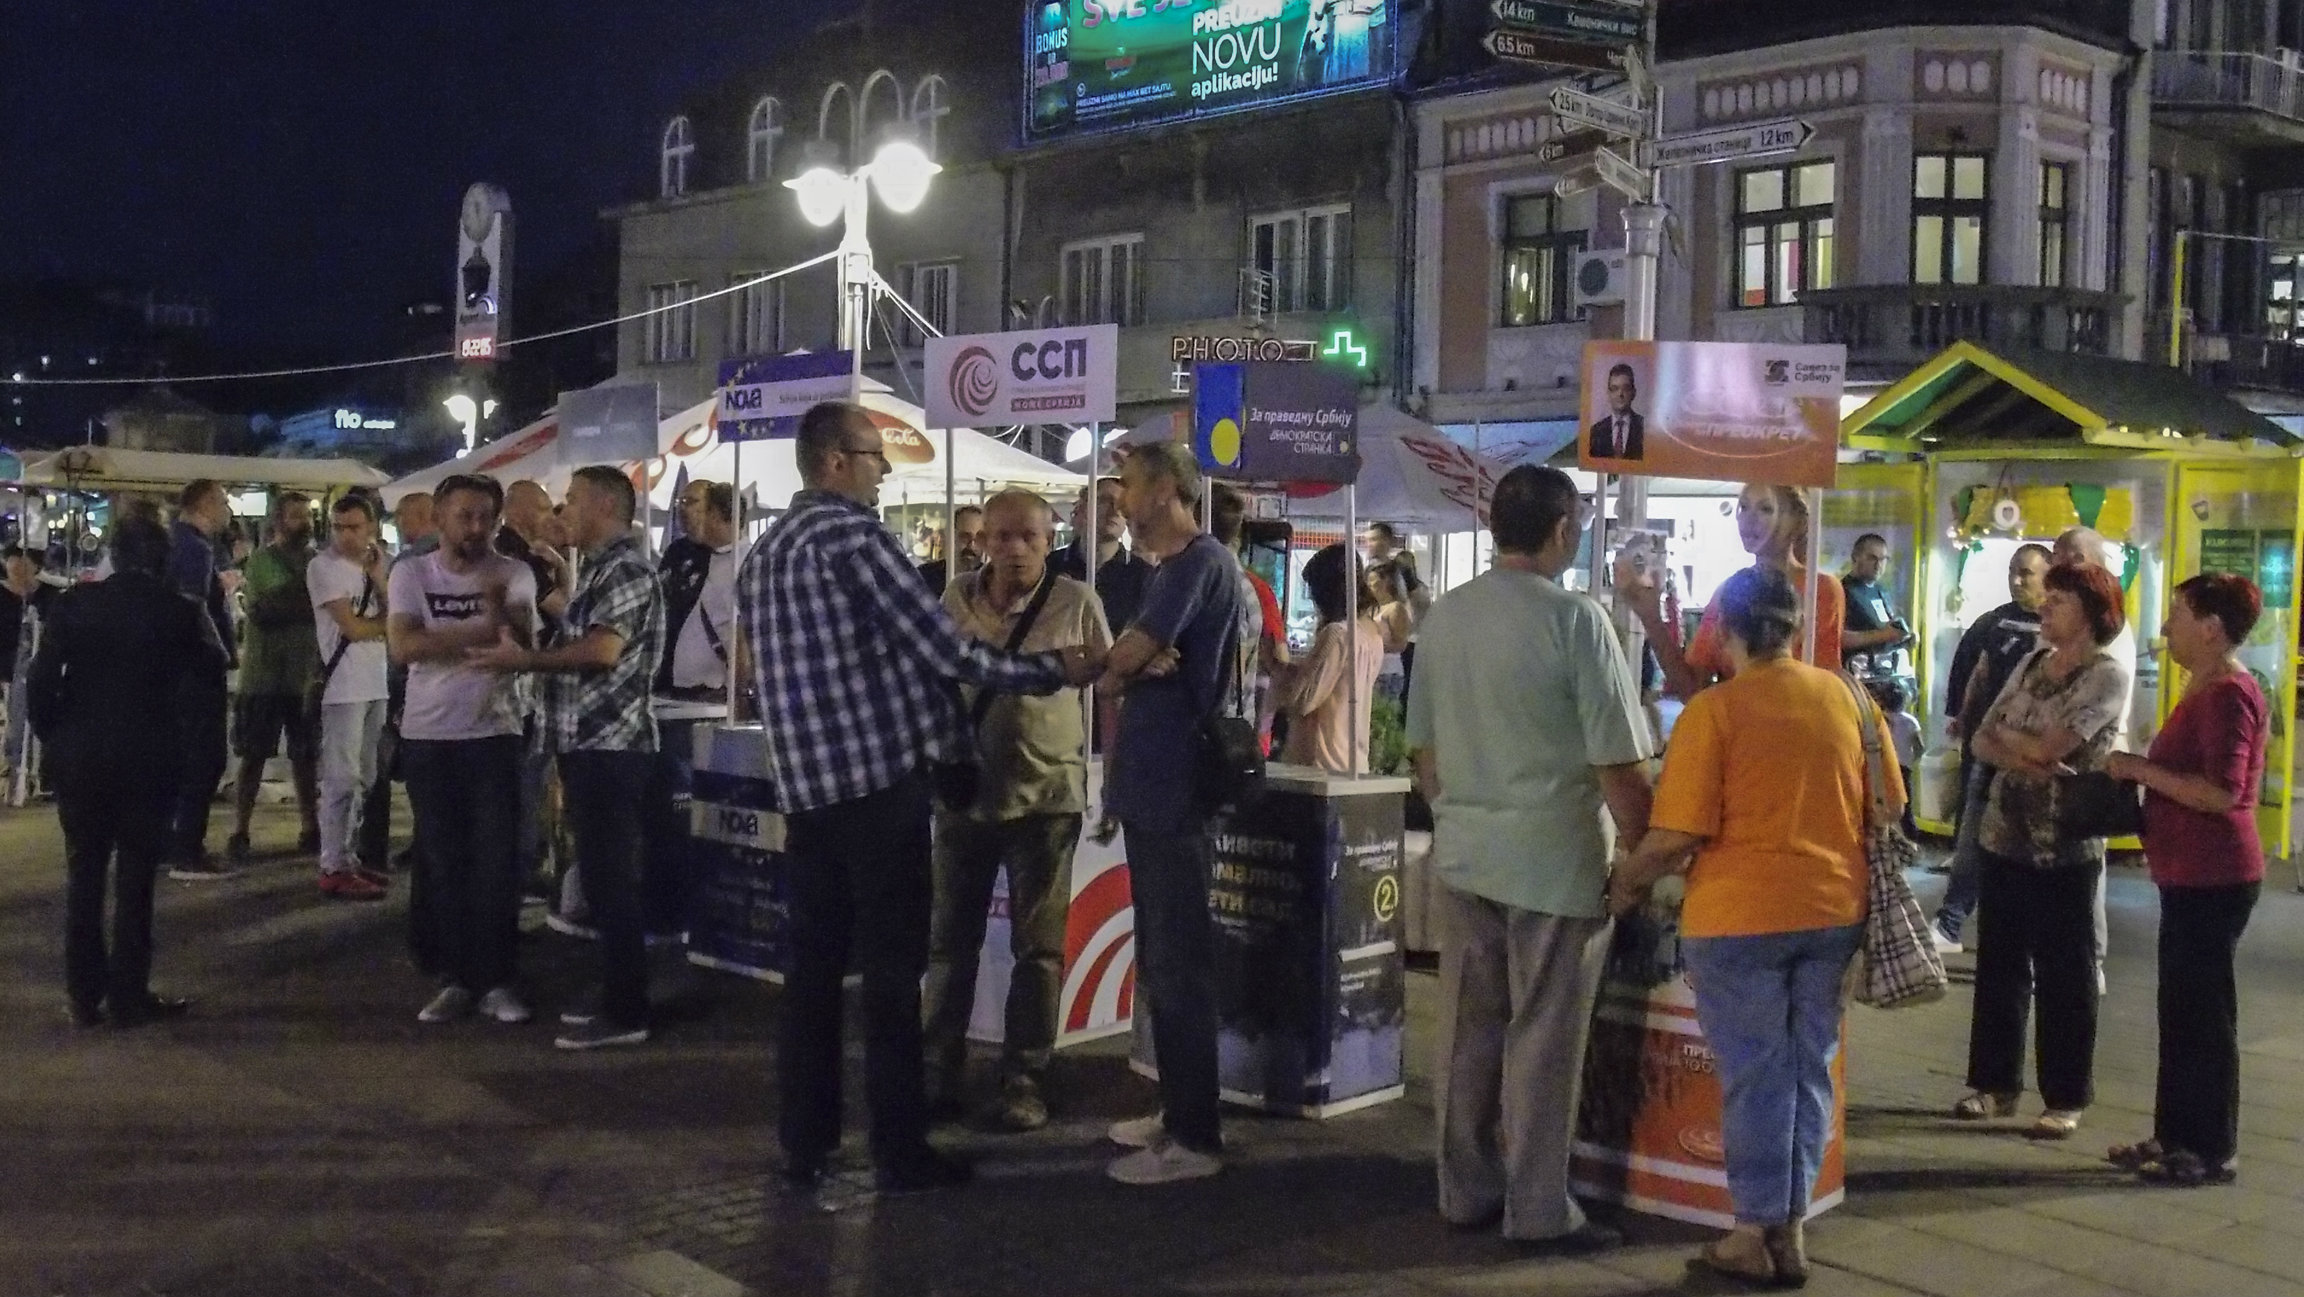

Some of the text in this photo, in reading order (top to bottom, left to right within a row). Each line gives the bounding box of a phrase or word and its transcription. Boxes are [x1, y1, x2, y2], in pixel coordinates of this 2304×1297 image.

[1517, 3, 1535, 21] km
[1036, 27, 1068, 54] BONUS
[1192, 22, 1281, 75] NOVU
[1516, 40, 1535, 55] km
[1191, 62, 1279, 100] aplikaciju!
[1776, 129, 1793, 145] km
[1172, 336, 1283, 361] PHOTO
[1011, 338, 1087, 381] ССП
[1250, 407, 1352, 428] За праведну Србију
[1269, 429, 1332, 443] ДЕМОКРАТСКА
[1294, 442, 1332, 454] СТРАНКА
